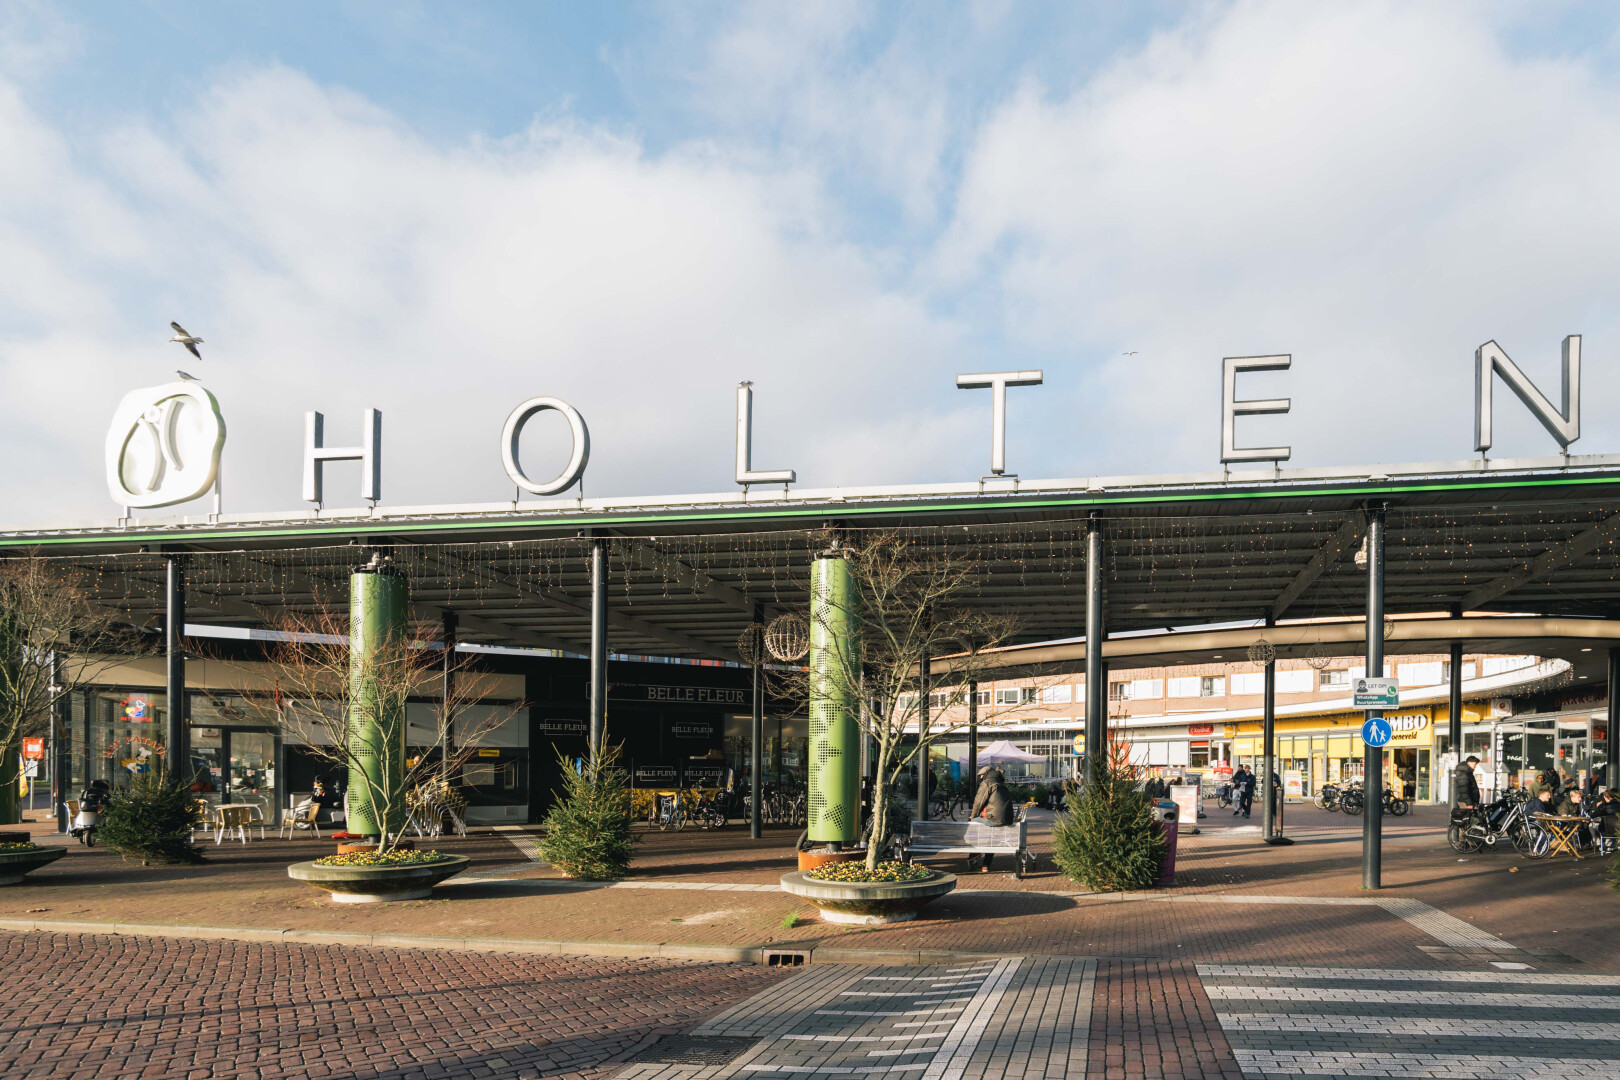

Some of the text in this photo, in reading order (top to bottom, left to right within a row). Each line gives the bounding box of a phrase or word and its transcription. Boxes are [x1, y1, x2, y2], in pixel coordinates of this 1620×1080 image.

[302, 334, 1582, 502] HOLTEN
[647, 686, 745, 703] BELLE FLEUR
[539, 723, 588, 732] BELLE FLEUR
[693, 726, 714, 734] FLEUR
